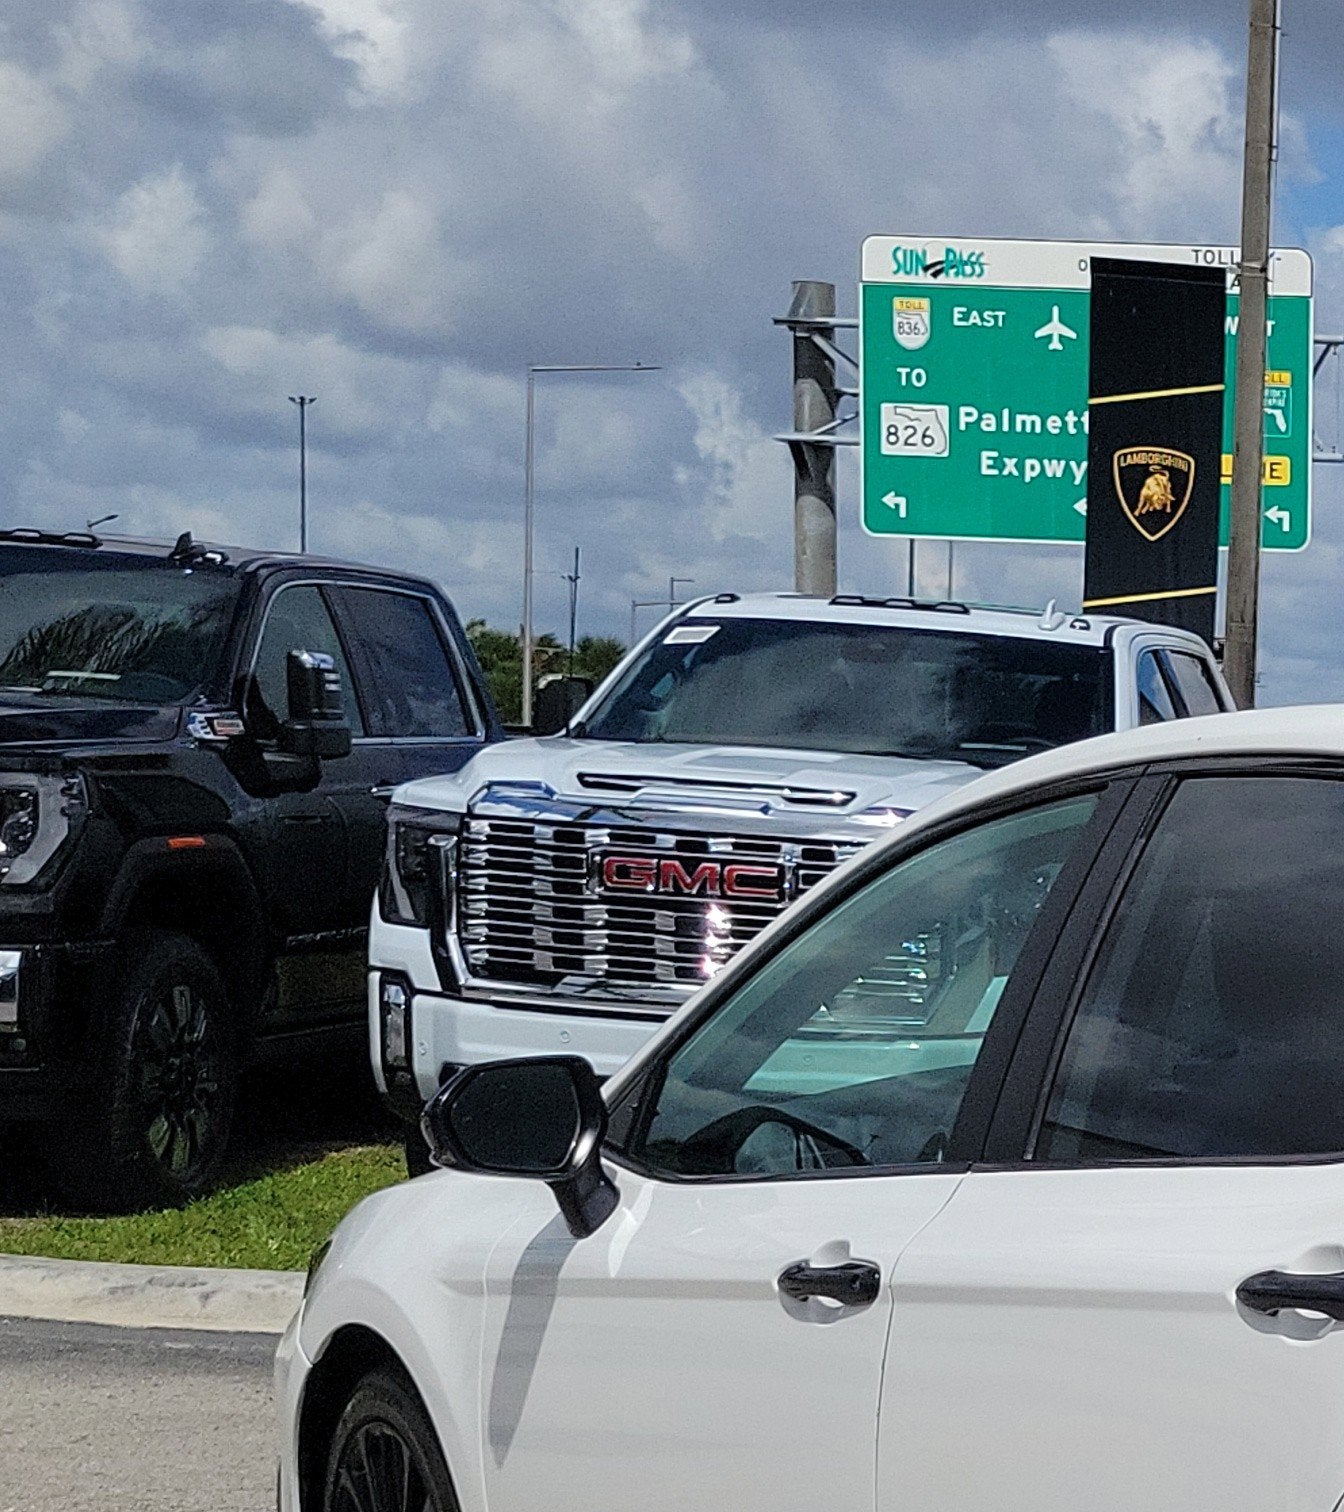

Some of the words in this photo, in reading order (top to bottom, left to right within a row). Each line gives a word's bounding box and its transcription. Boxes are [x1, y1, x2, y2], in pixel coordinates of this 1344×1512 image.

[899, 300, 925, 311] TOLL
[953, 306, 1006, 328] EAST
[897, 320, 921, 336] 836
[896, 367, 927, 388] TO
[958, 406, 1090, 435] Palmett
[885, 424, 936, 448] 826
[980, 450, 1089, 486] Expwy
[603, 856, 779, 900] GMC
